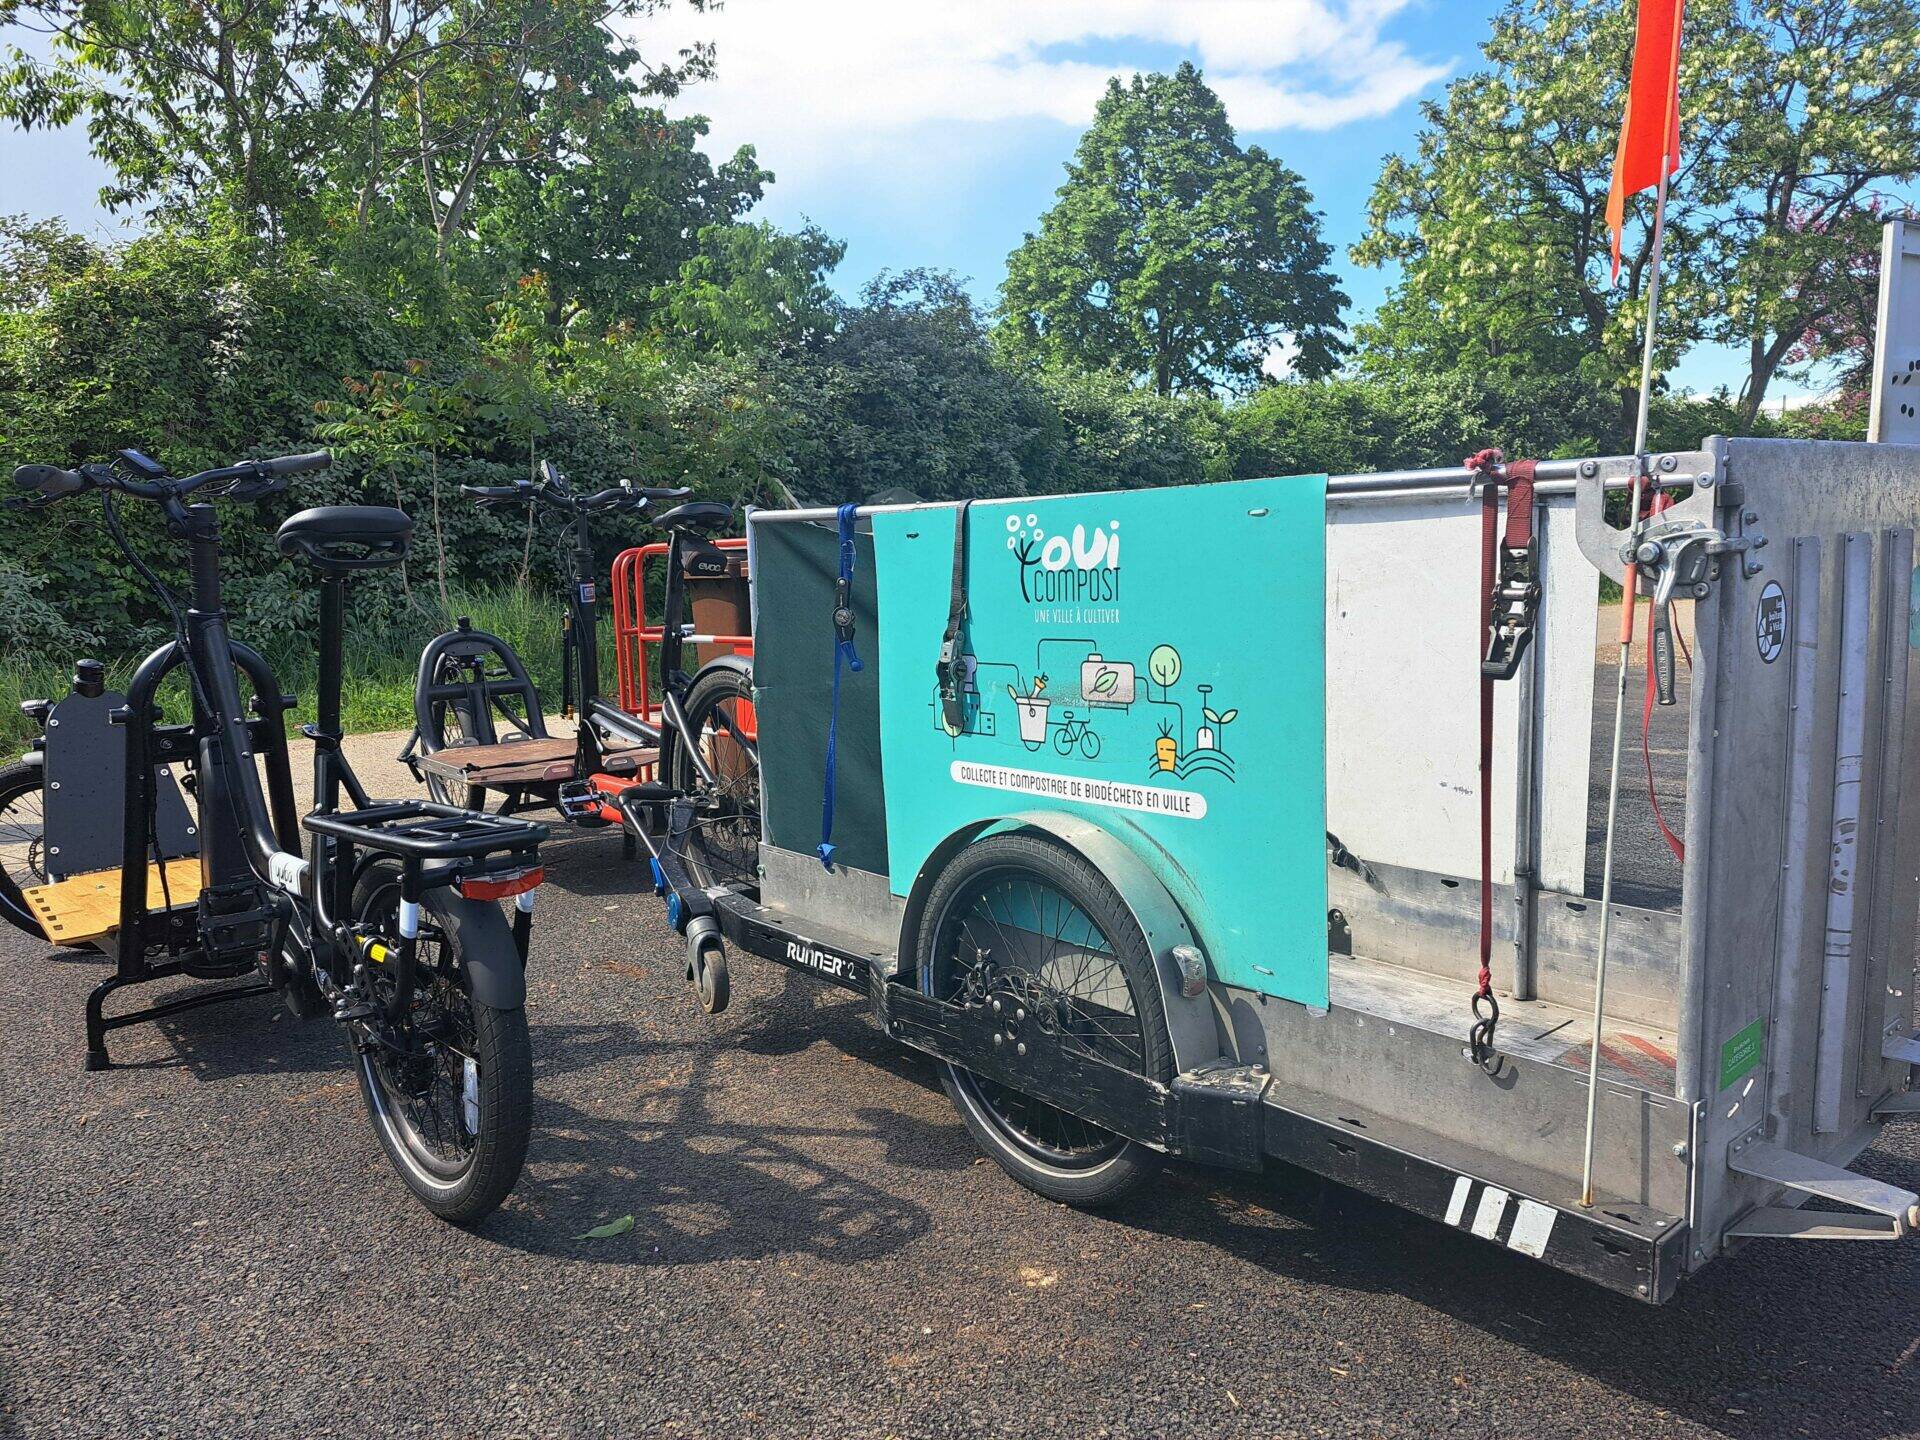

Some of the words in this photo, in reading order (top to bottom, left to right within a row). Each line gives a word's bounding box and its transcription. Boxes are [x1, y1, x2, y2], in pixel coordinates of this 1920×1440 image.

[1034, 567, 1121, 603] COMPOST
[1034, 608, 1050, 623] UNE
[1052, 608, 1073, 623] VILLE
[1076, 606, 1081, 623] À
[1083, 608, 1120, 624] CULTIVER
[961, 766, 997, 784] COLLECTE
[1000, 771, 1010, 786] ET
[1010, 773, 1068, 795] COMPOSTAGE
[1070, 782, 1082, 797] DE
[1085, 780, 1143, 806] BIODÉCHETS
[1146, 793, 1159, 808] EN
[1162, 795, 1191, 813] VILLE
[786, 941, 842, 976] RUNNER
